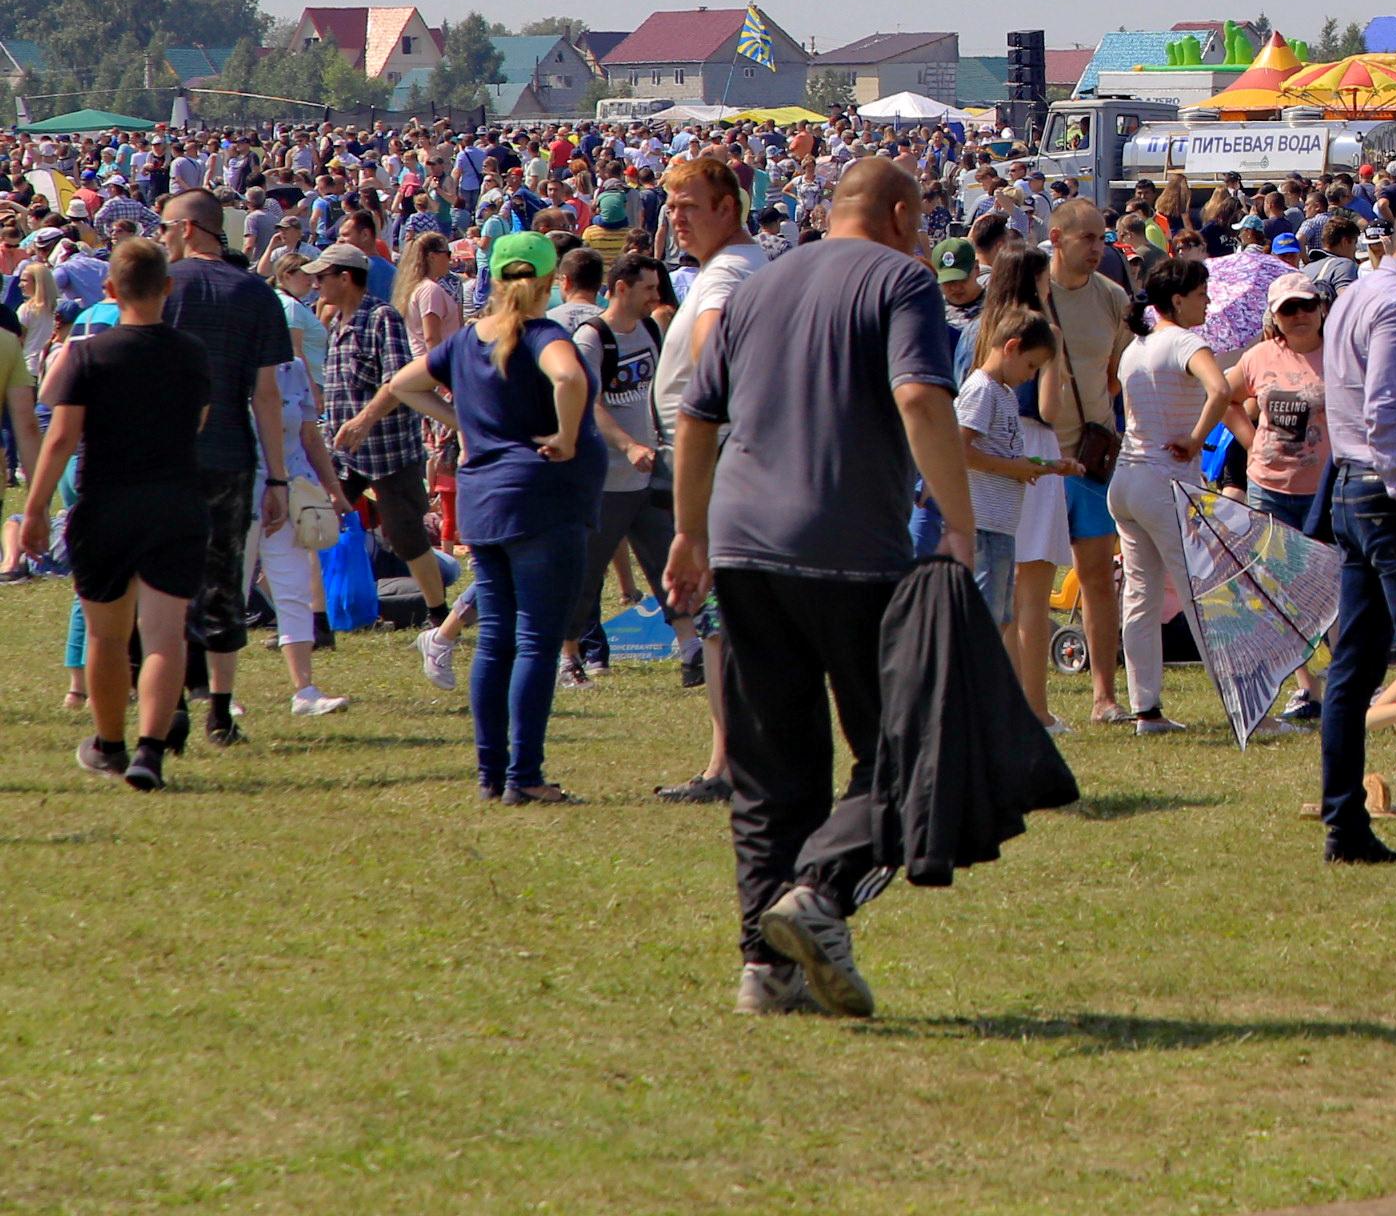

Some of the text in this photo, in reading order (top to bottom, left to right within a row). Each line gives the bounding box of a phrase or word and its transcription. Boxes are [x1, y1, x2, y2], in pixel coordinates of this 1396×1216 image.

[1192, 135, 1321, 154] ПИТЬЕВАЯ ВОДА
[1269, 401, 1308, 412] FEELING
[1274, 415, 1297, 426] GOOD
